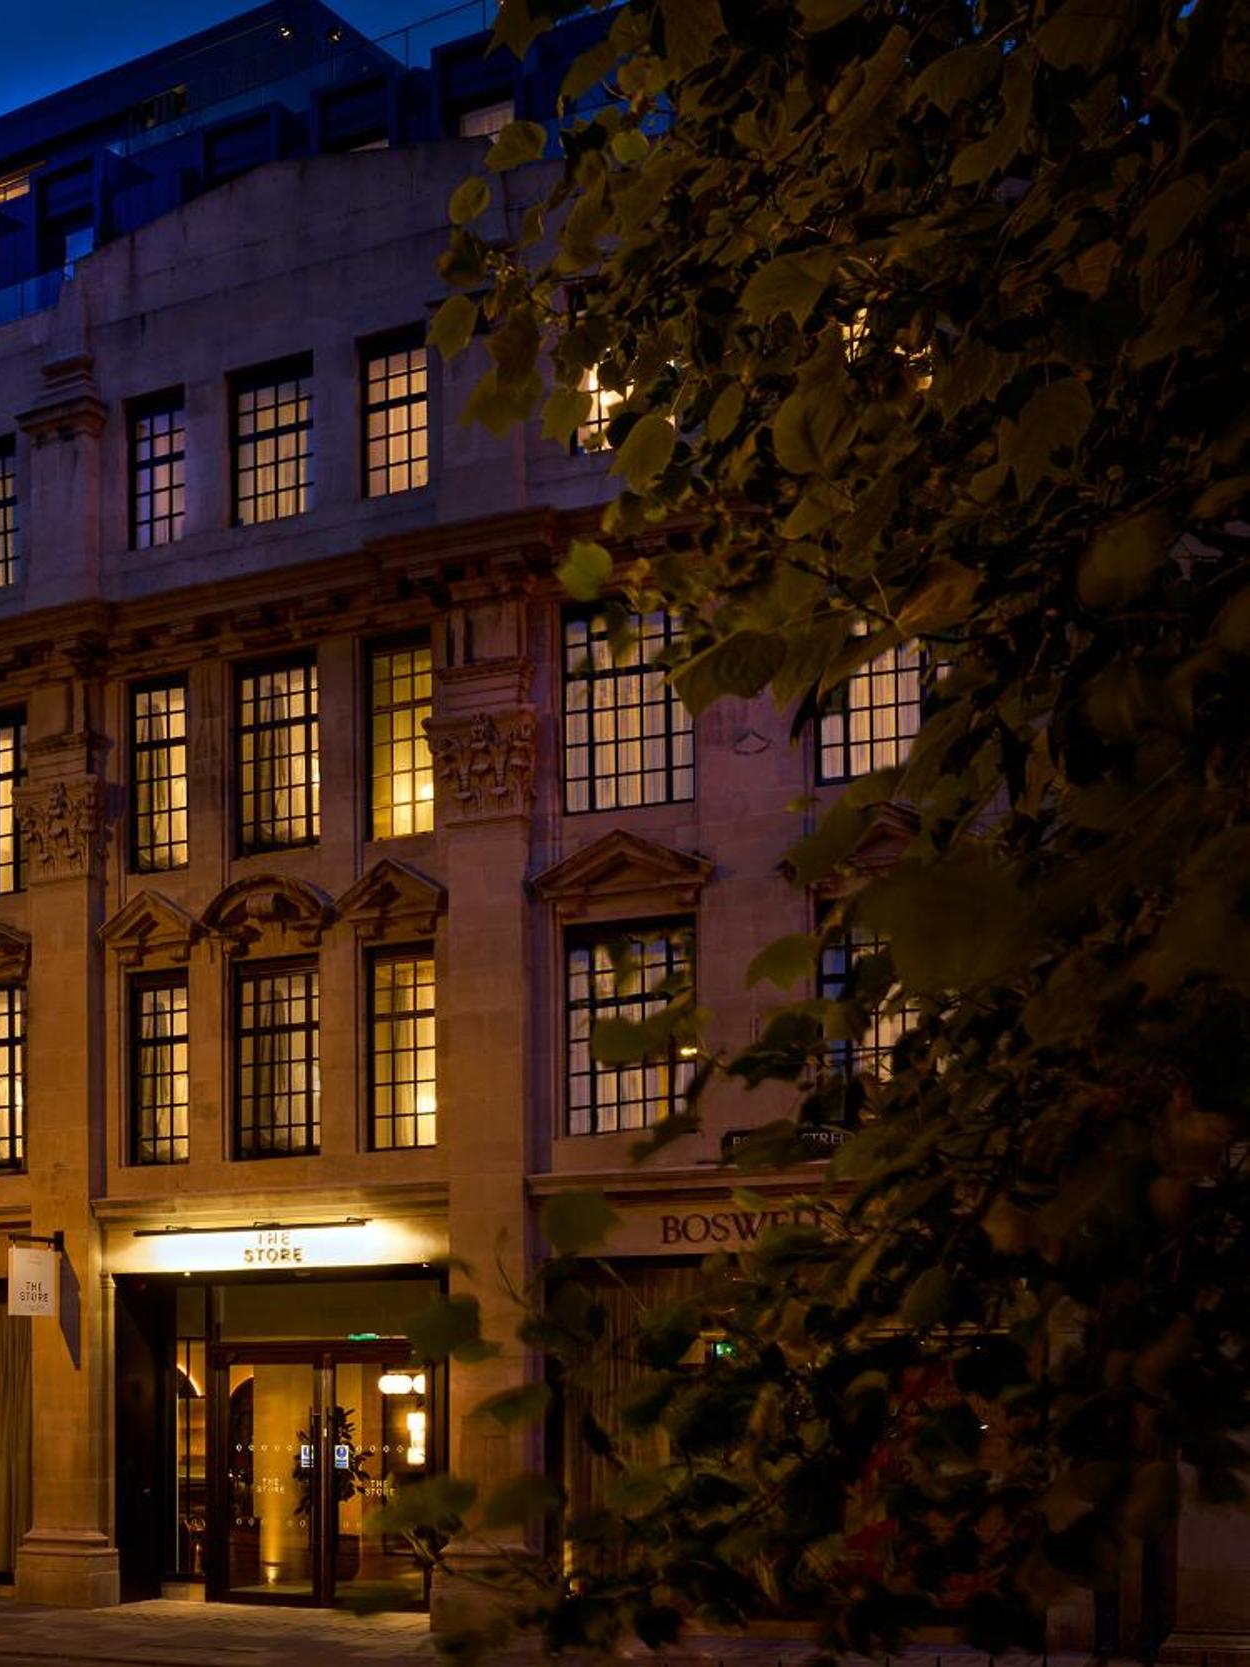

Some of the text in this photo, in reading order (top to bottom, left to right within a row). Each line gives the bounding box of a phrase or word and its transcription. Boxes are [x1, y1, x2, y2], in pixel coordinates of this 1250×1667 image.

[257, 1231, 290, 1246] THE
[244, 1248, 302, 1264] STORE
[25, 1281, 43, 1292] THE
[20, 1291, 49, 1303] STORE
